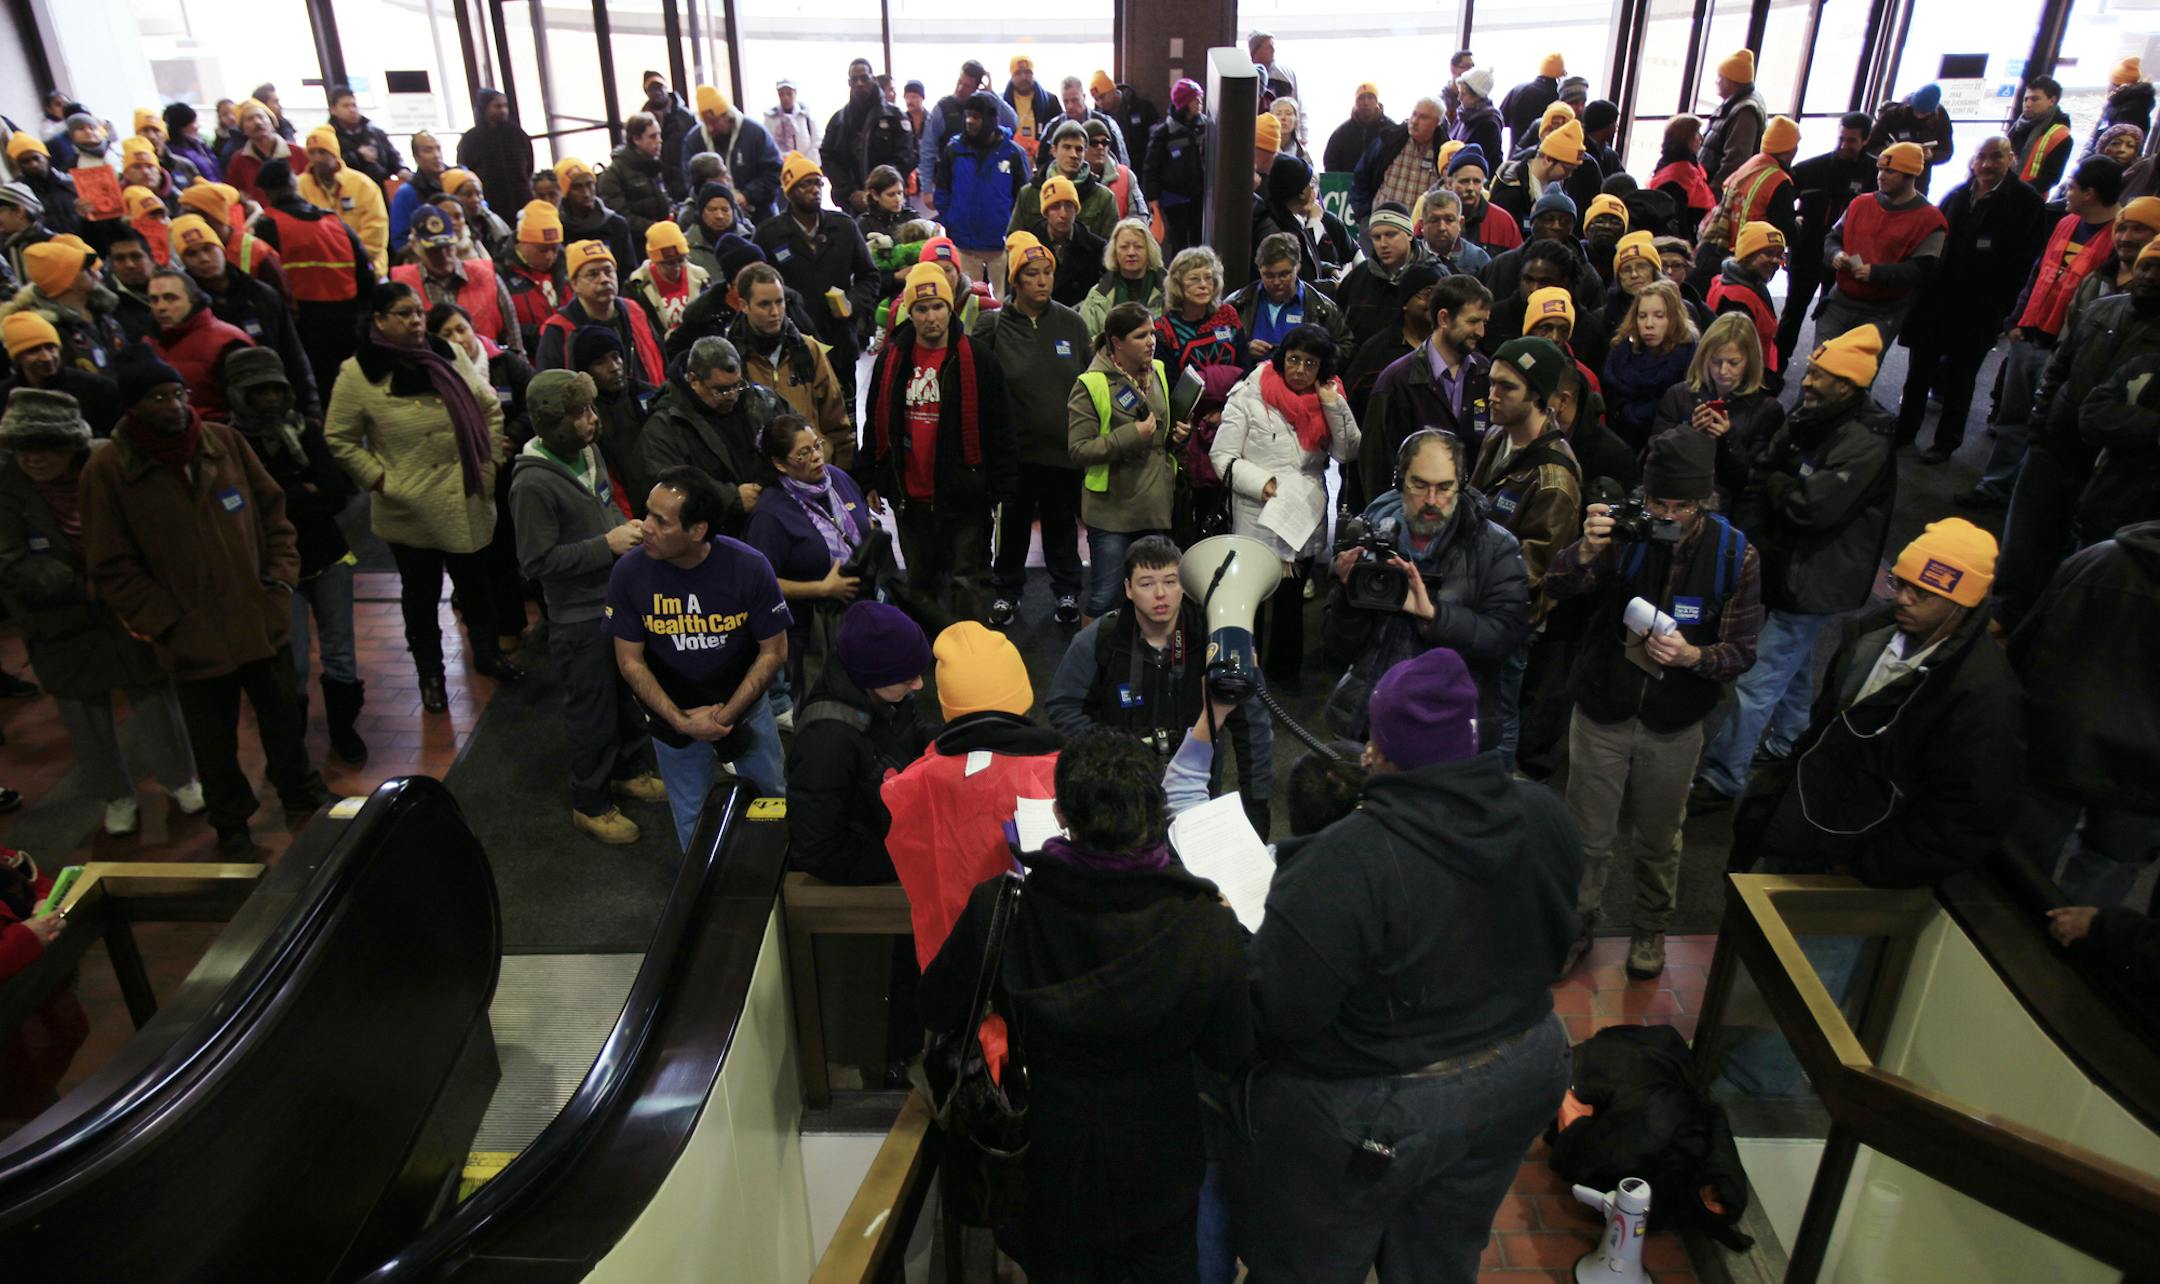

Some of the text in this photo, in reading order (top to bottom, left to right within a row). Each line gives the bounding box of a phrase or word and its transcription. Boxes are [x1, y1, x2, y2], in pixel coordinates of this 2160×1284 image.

[653, 593, 702, 615] I'm A
[641, 614, 708, 635] Health
[671, 633, 729, 651] Voter
